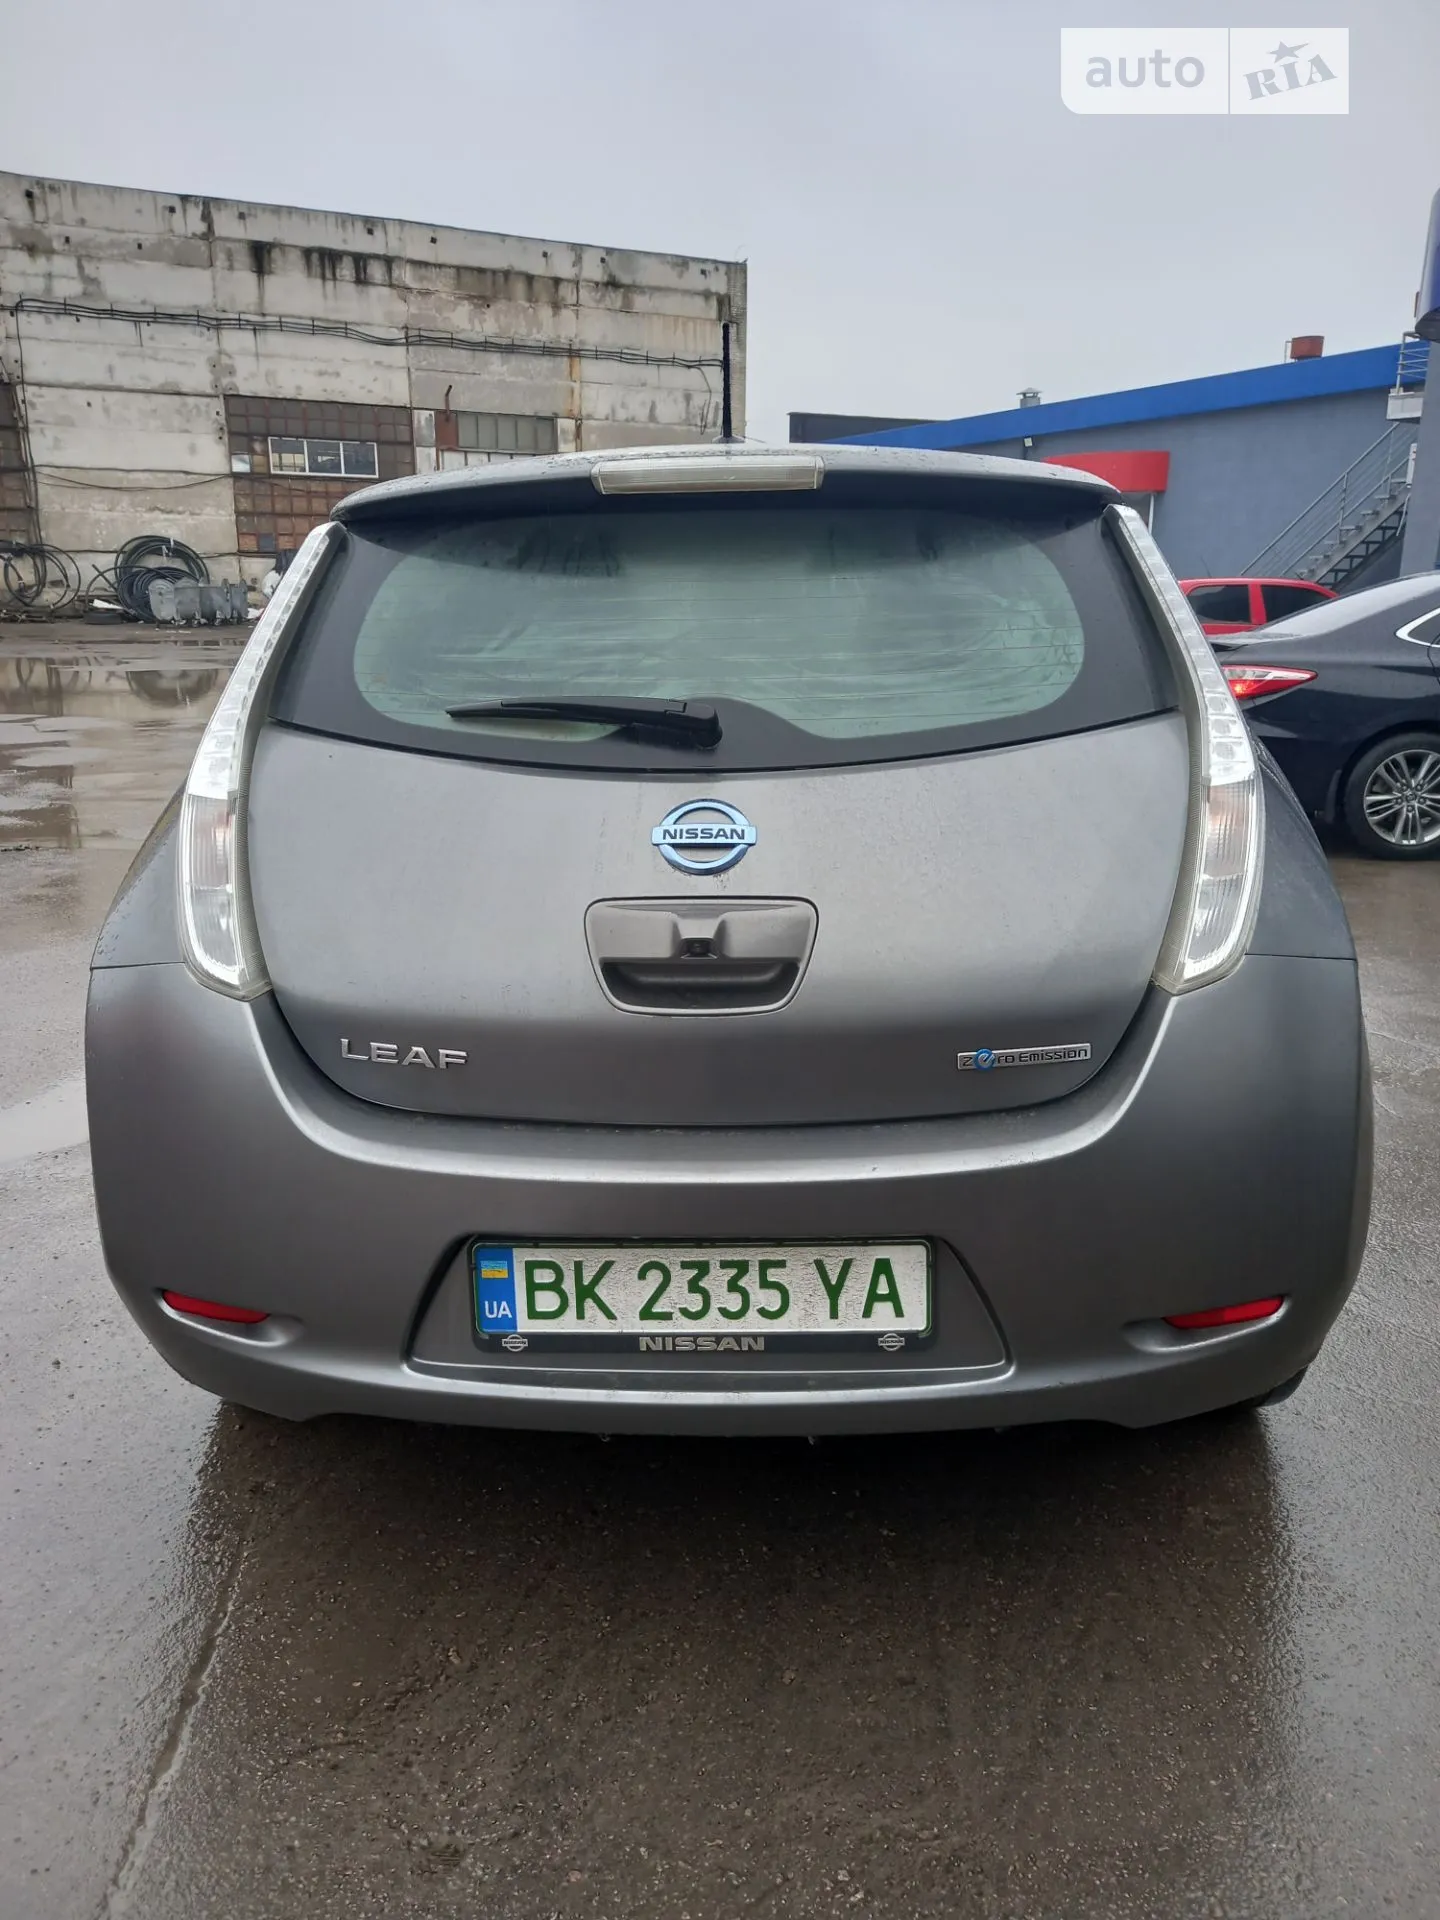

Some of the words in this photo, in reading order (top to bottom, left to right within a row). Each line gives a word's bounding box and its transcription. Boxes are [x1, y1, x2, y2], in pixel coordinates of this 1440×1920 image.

[662, 828, 745, 840] NISSAN
[340, 1038, 468, 1069] LEAF
[1018, 1048, 1087, 1063] Emission
[524, 1259, 618, 1320] BK
[637, 1258, 790, 1320] 2335
[814, 1258, 905, 1319] YA
[484, 1300, 512, 1318] UA
[639, 1336, 764, 1351] NISSAN
